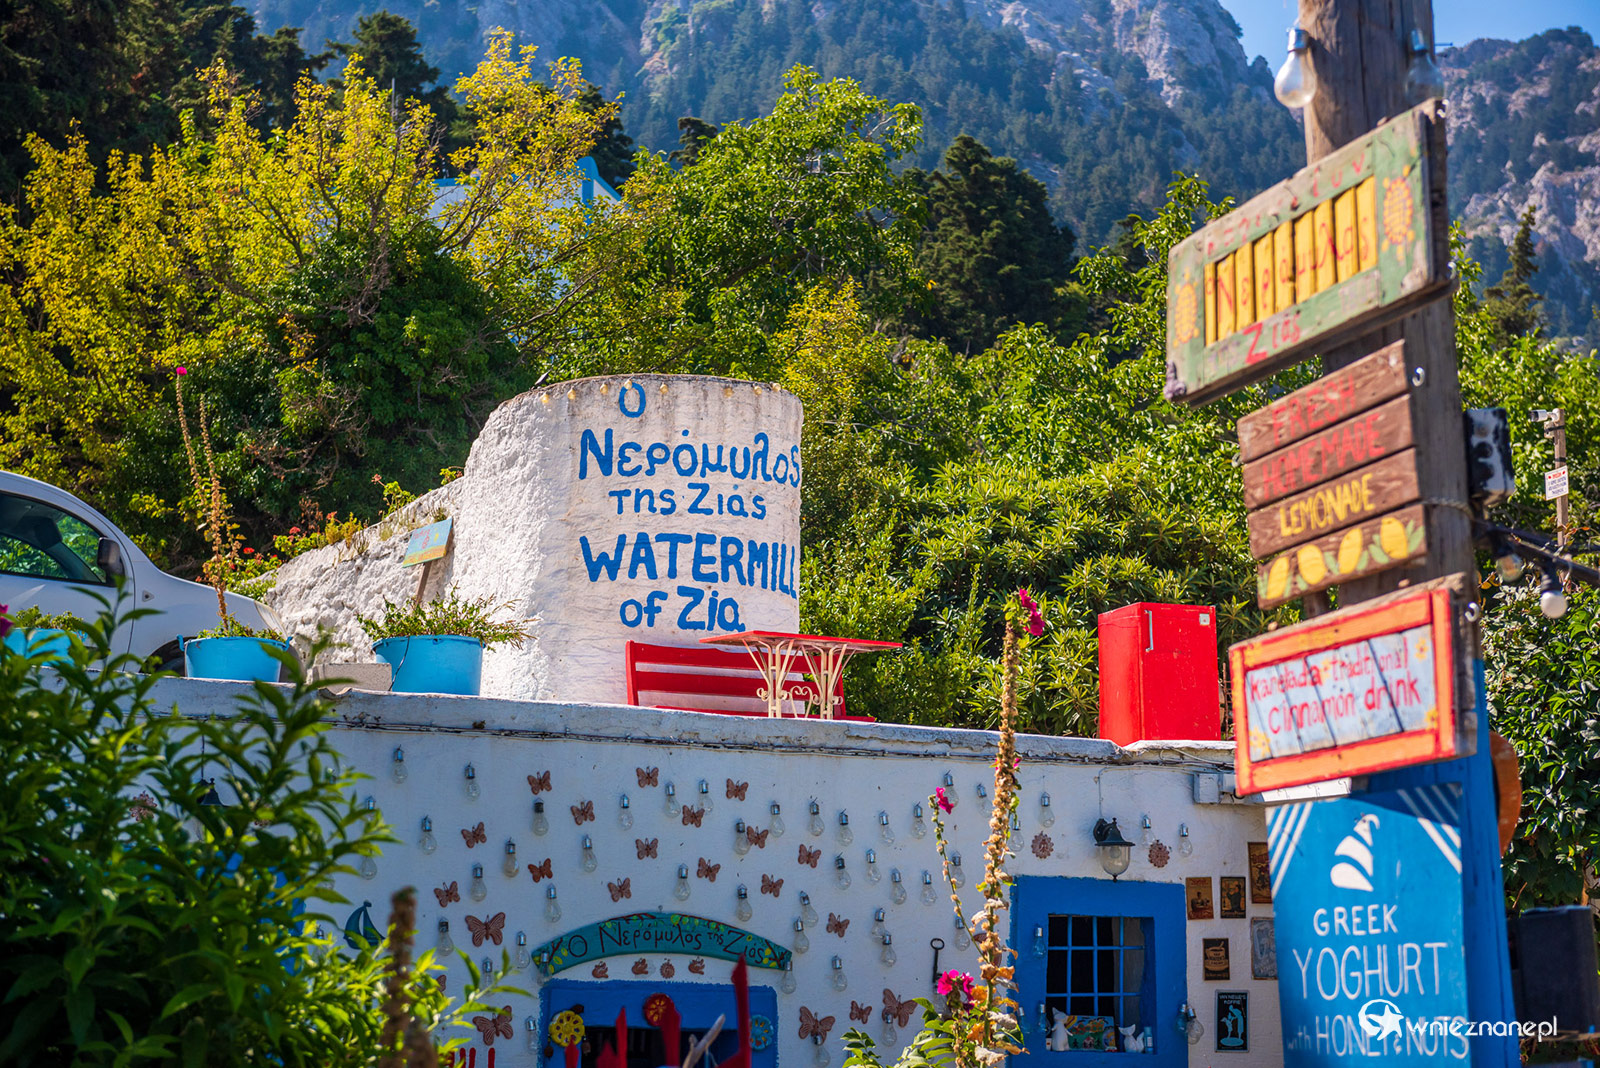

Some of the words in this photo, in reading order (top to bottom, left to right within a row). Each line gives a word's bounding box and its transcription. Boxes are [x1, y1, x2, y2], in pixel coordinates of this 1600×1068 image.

[1272, 374, 1357, 447] FRESH
[1279, 473, 1376, 537] LEMONADE
[579, 532, 797, 599] WATERMILL
[619, 590, 668, 628] of
[677, 585, 745, 632] Zia
[1268, 692, 1356, 734] cinnamon
[1364, 670, 1422, 711] drink
[1313, 904, 1398, 936] GREEK
[1292, 942, 1447, 1001] YOGHURT
